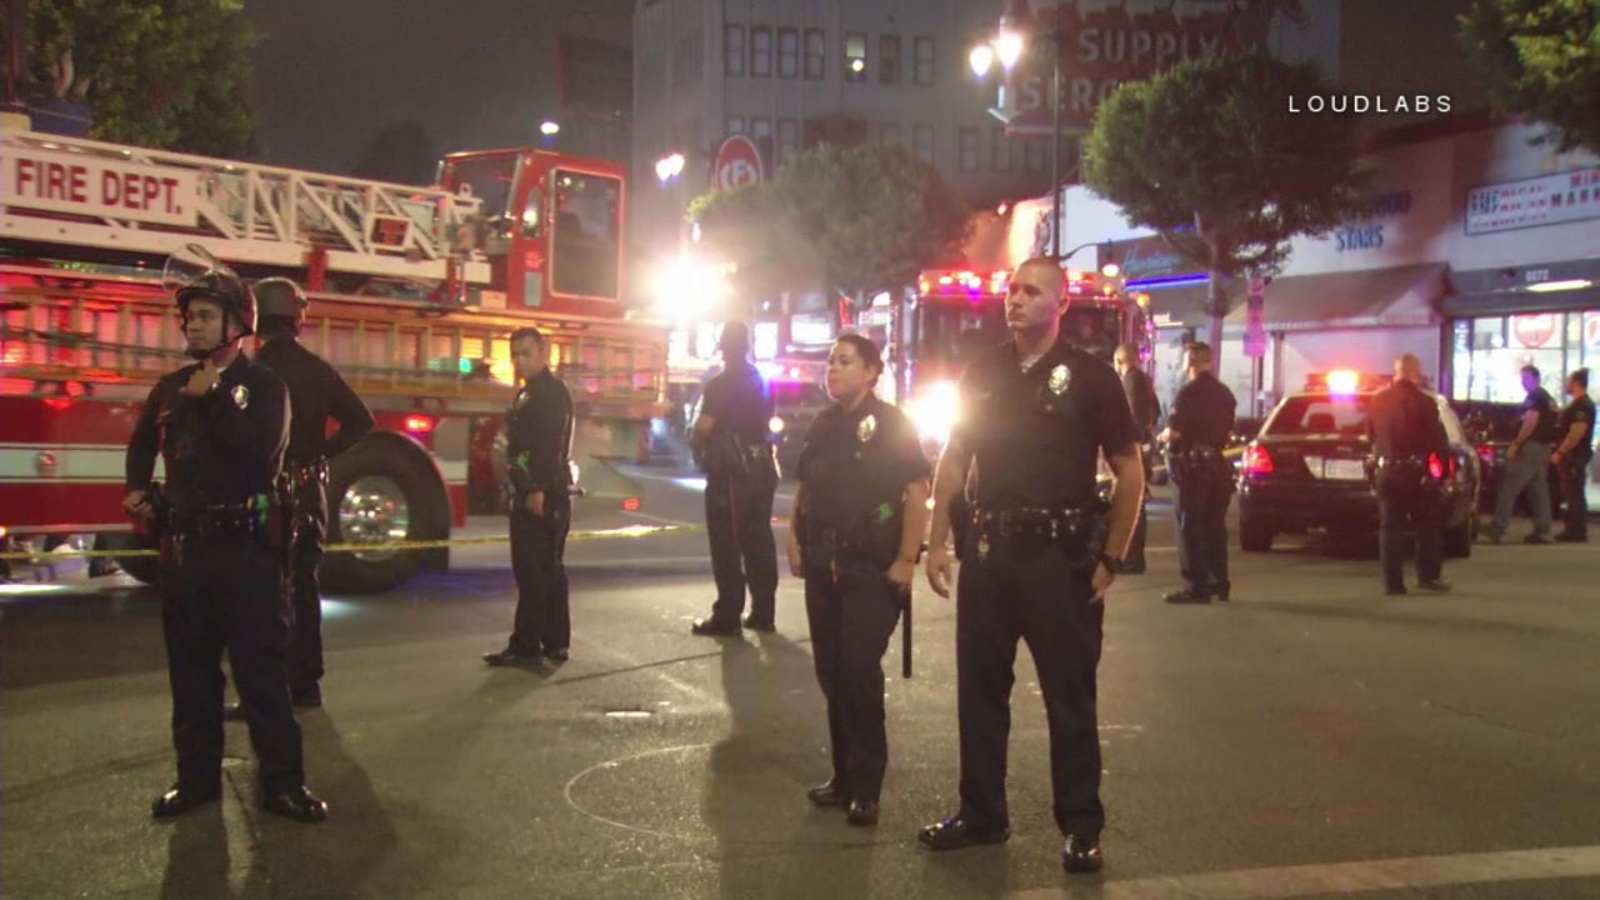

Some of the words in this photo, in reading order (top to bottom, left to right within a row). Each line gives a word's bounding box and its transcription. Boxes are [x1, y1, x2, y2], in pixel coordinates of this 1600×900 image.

[1078, 27, 1221, 63] SUPPLY
[17, 157, 88, 203] FIRE
[102, 169, 182, 215] DEPT.
[1335, 224, 1385, 253] STARS
